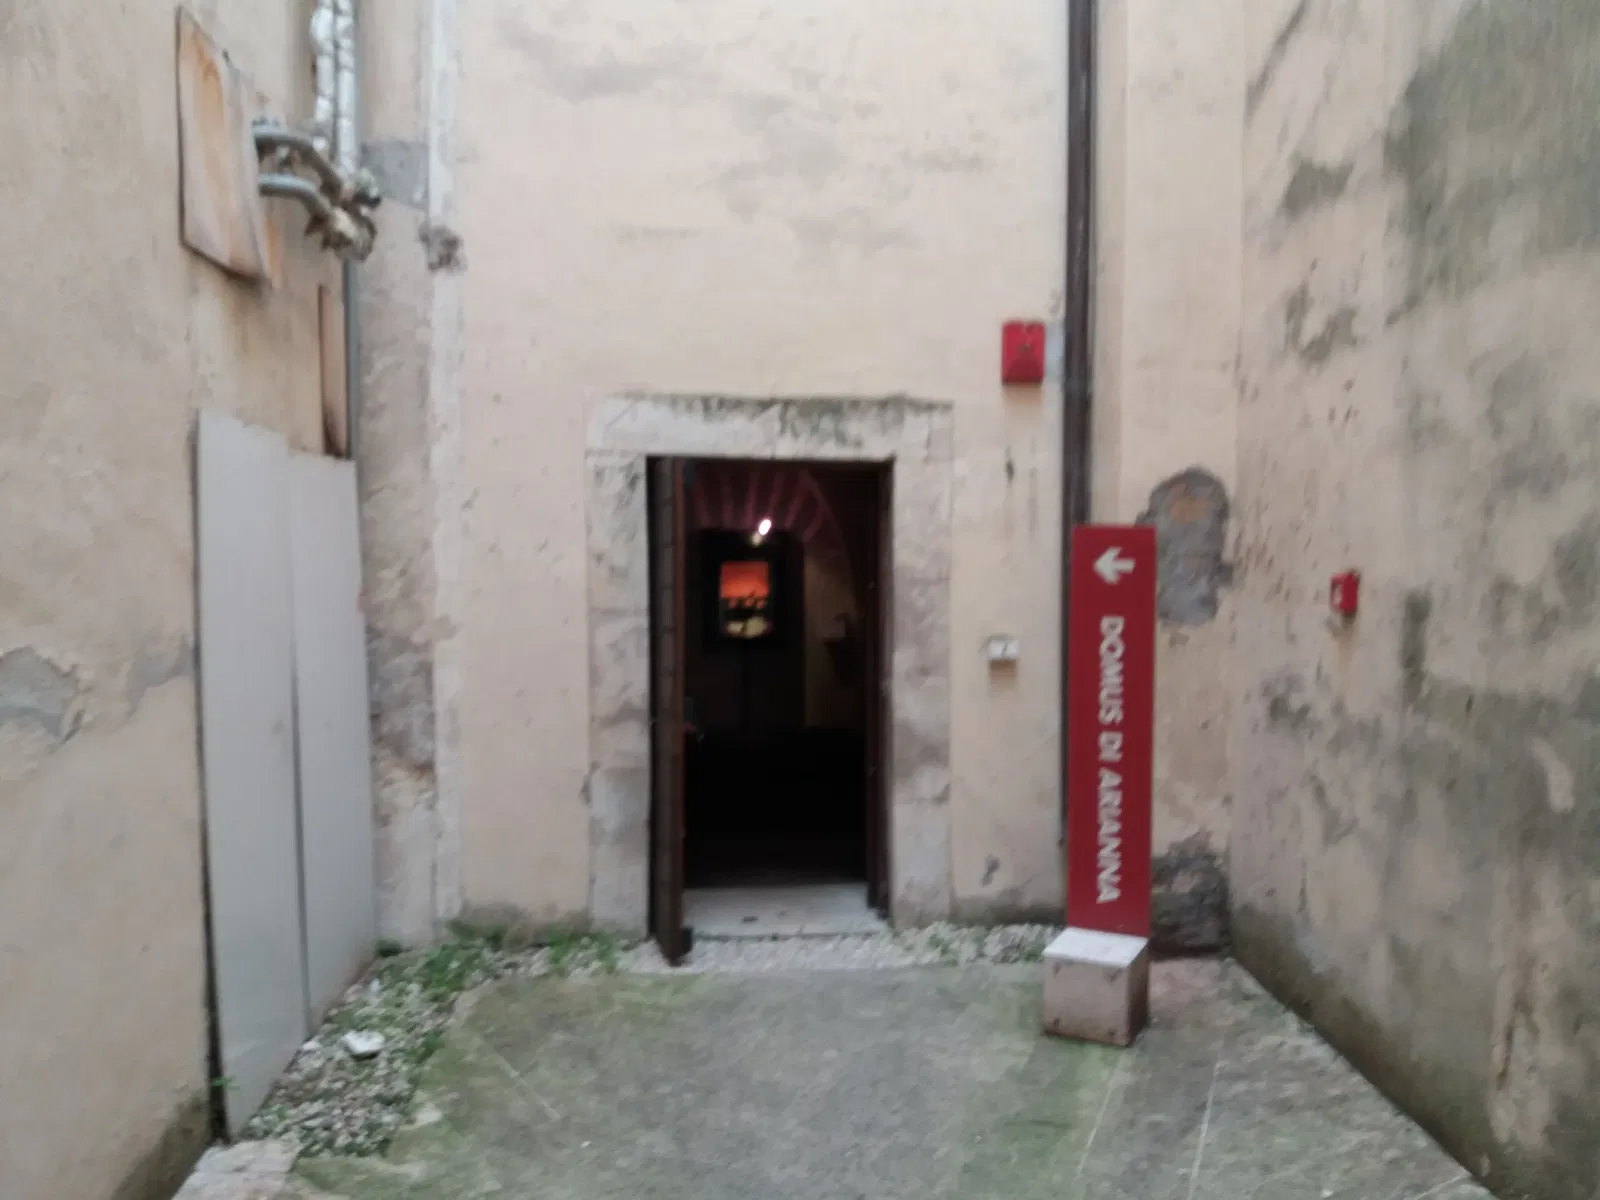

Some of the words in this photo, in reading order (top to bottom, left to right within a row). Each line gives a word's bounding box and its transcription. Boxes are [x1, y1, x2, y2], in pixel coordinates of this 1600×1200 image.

[1098, 616, 1125, 725] DOMUS
[1098, 730, 1124, 762] DI
[1096, 767, 1123, 904] ARIANNA
